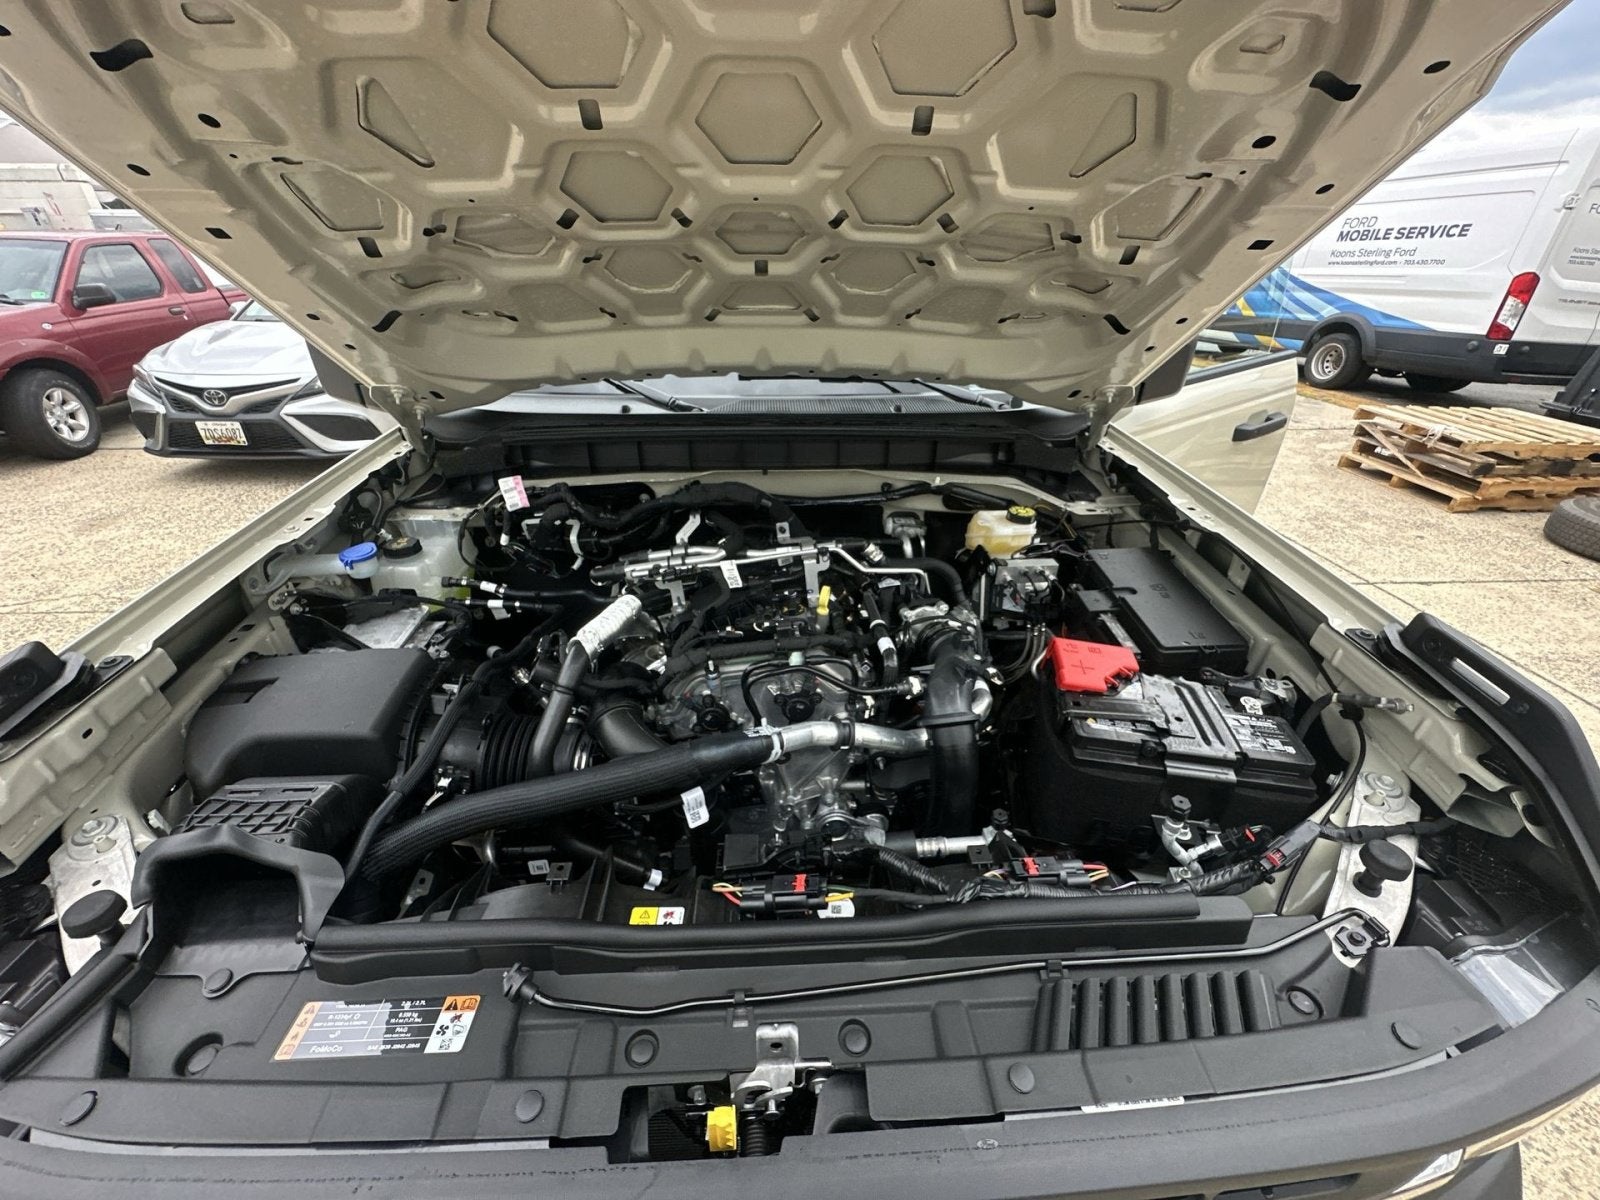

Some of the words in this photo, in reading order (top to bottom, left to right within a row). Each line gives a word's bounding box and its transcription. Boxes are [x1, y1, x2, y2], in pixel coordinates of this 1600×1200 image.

[1342, 216, 1378, 229] FORD
[1336, 228, 1394, 242] MOBILE
[1394, 223, 1473, 240] SERVICE
[1330, 248, 1356, 258] Koons
[1357, 247, 1392, 258] Sterling
[1393, 246, 1418, 257] Ford
[309, 1044, 343, 1053] FoMoCo
